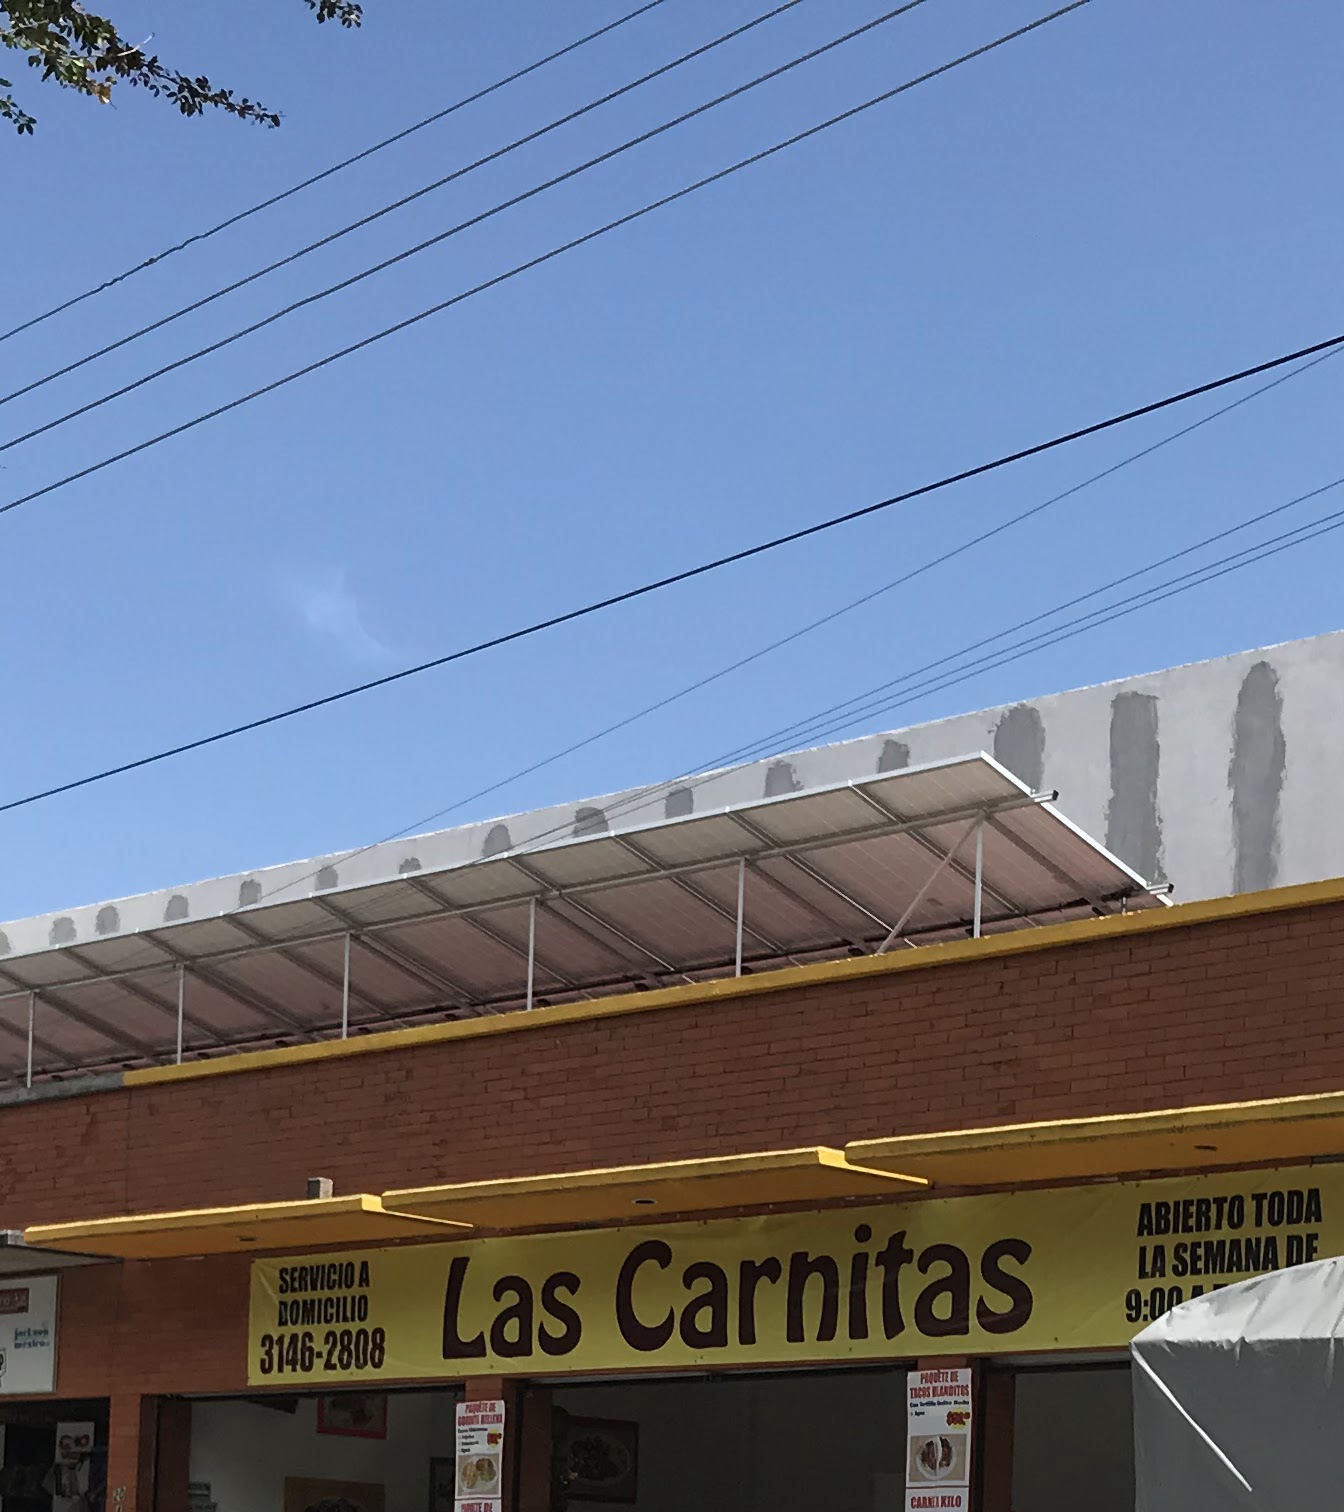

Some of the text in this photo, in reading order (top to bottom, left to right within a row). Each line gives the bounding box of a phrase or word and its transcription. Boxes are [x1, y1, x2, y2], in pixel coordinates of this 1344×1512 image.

[1137, 1188, 1322, 1237] ABIERTO TODA
[279, 1261, 370, 1294] SERVICIO A
[1138, 1232, 1319, 1279] LA SEMANA DE
[278, 1295, 369, 1327] DOMICILIO
[442, 1223, 1034, 1359] Las Carnitas
[260, 1327, 386, 1375] 3146-2808
